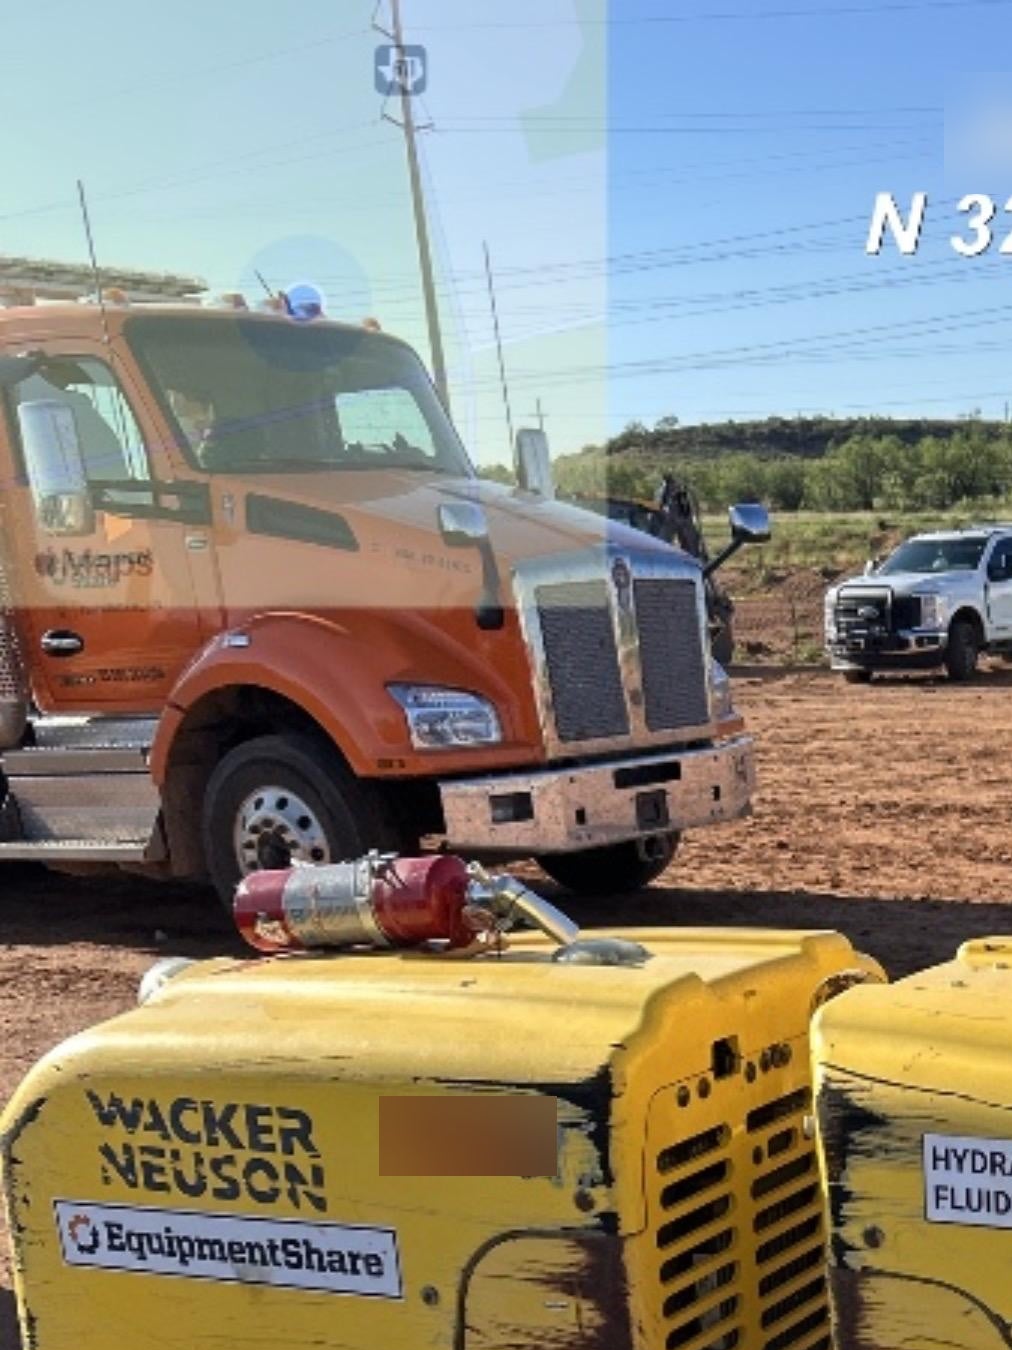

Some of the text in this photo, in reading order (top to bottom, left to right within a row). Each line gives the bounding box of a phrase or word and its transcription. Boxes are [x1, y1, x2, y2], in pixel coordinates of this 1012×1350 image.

[86, 1089, 322, 1158] WACKER
[98, 1142, 328, 1212] NEUSON
[934, 1185, 1012, 1216] FLUID
[103, 1220, 385, 1279] EquipmentShare
